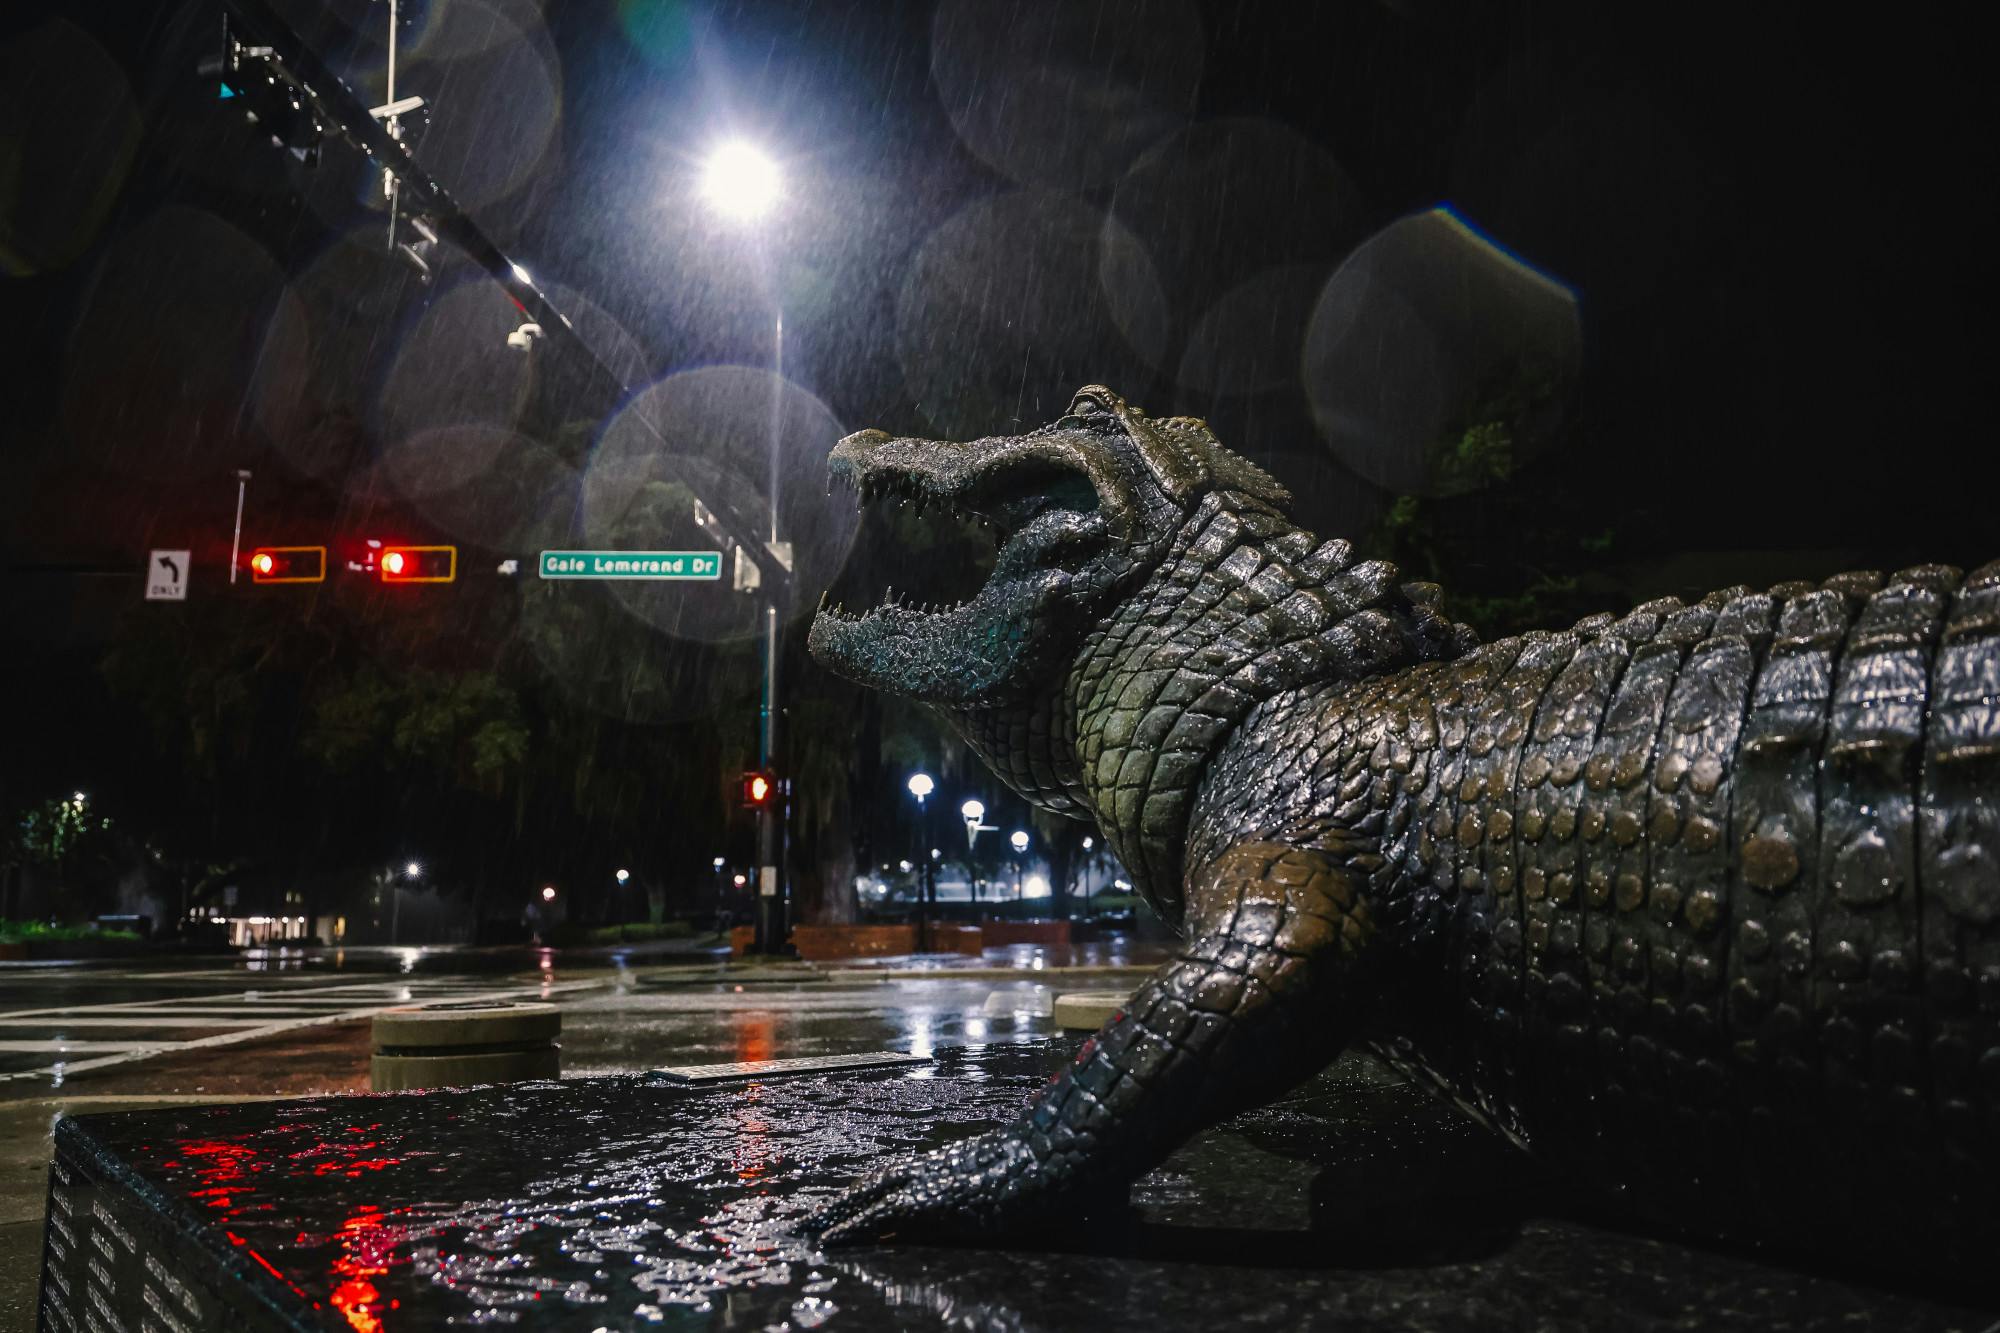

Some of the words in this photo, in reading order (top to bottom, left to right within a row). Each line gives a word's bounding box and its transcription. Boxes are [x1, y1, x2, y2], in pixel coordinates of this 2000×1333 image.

[546, 556, 586, 572] Gale
[594, 557, 684, 573] Lemerand
[692, 558, 714, 573] Dr
